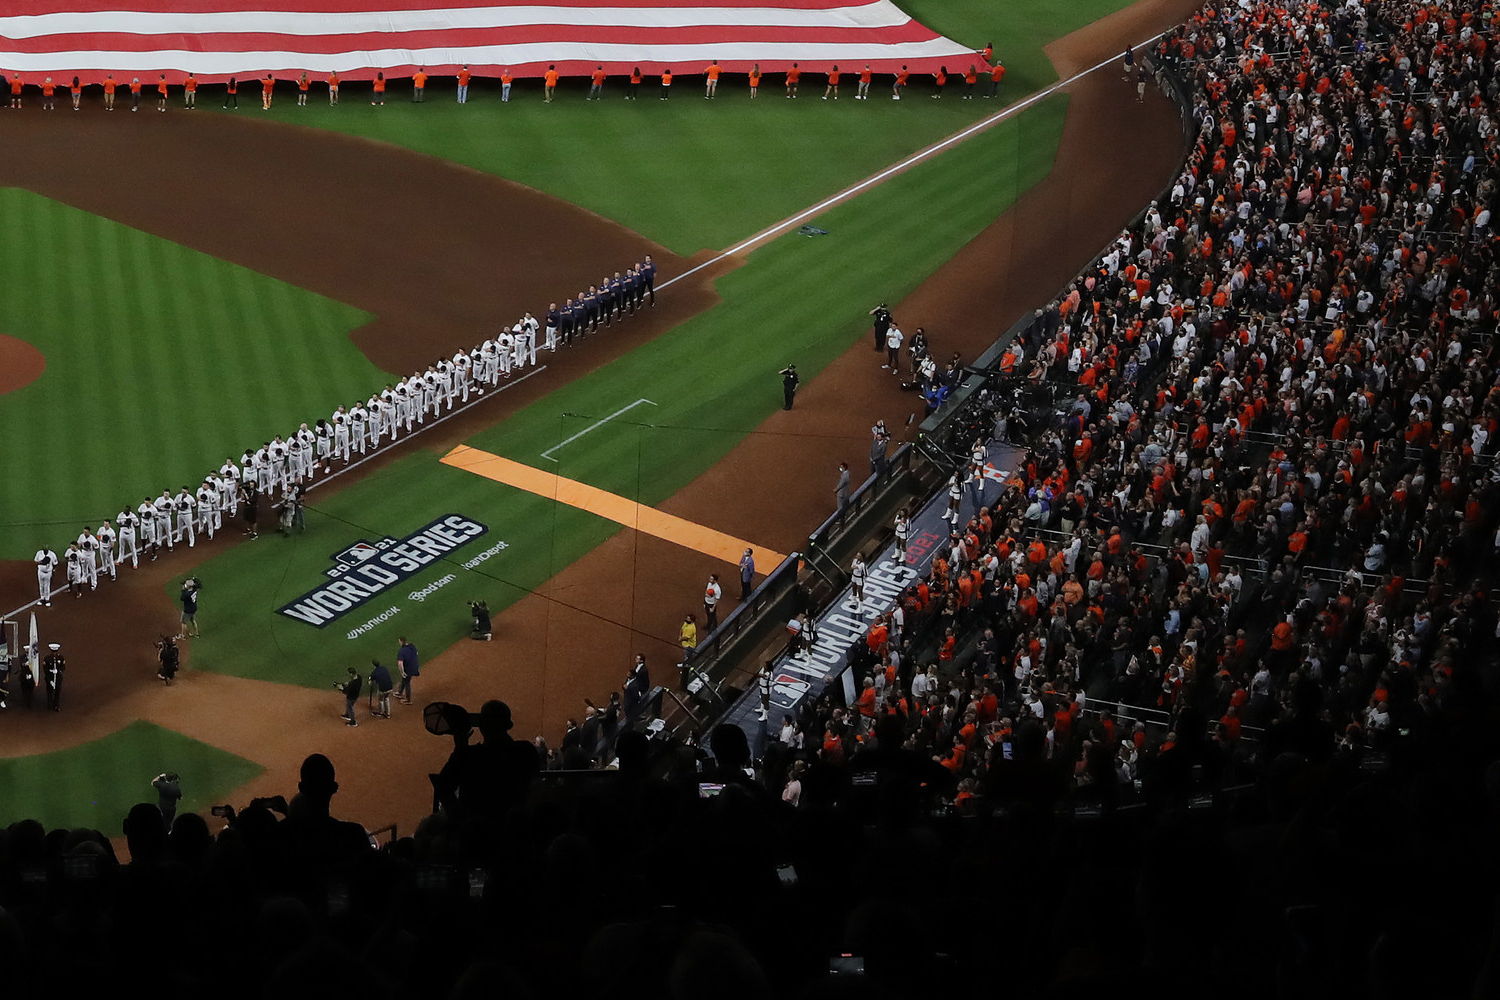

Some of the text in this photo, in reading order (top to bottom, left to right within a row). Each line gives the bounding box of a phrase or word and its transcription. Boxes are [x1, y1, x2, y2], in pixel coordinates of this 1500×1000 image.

[284, 516, 484, 625] WORLD SERIES
[461, 541, 509, 570] loanDepot
